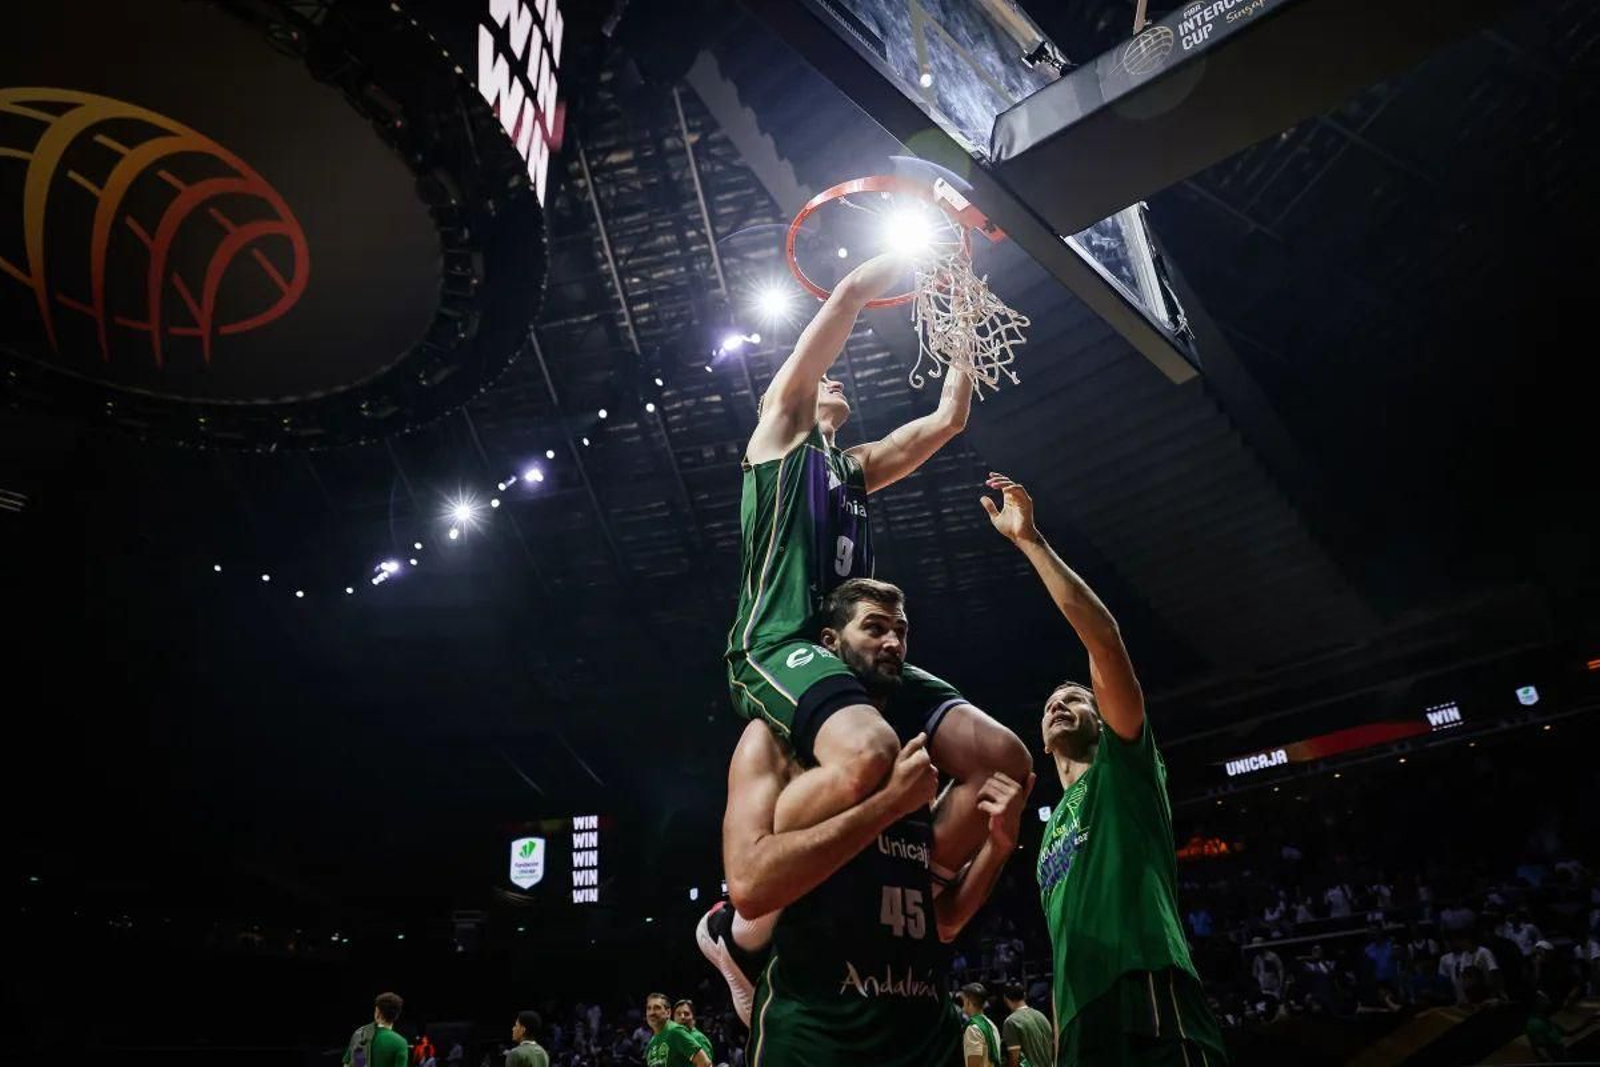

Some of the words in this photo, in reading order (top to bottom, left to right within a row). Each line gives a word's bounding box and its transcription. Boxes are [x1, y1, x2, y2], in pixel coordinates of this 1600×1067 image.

[1178, 0, 1243, 37] INTERC
[1181, 23, 1213, 51] CUP
[834, 535, 854, 577] 9
[1426, 705, 1462, 727] WIN
[1225, 749, 1289, 777] UNICAJA
[572, 815, 598, 830] WIN
[572, 832, 598, 849] WIN
[572, 850, 598, 868] WIN
[572, 869, 598, 887] WIN
[572, 888, 598, 904] WIN
[880, 885, 926, 940] 45
